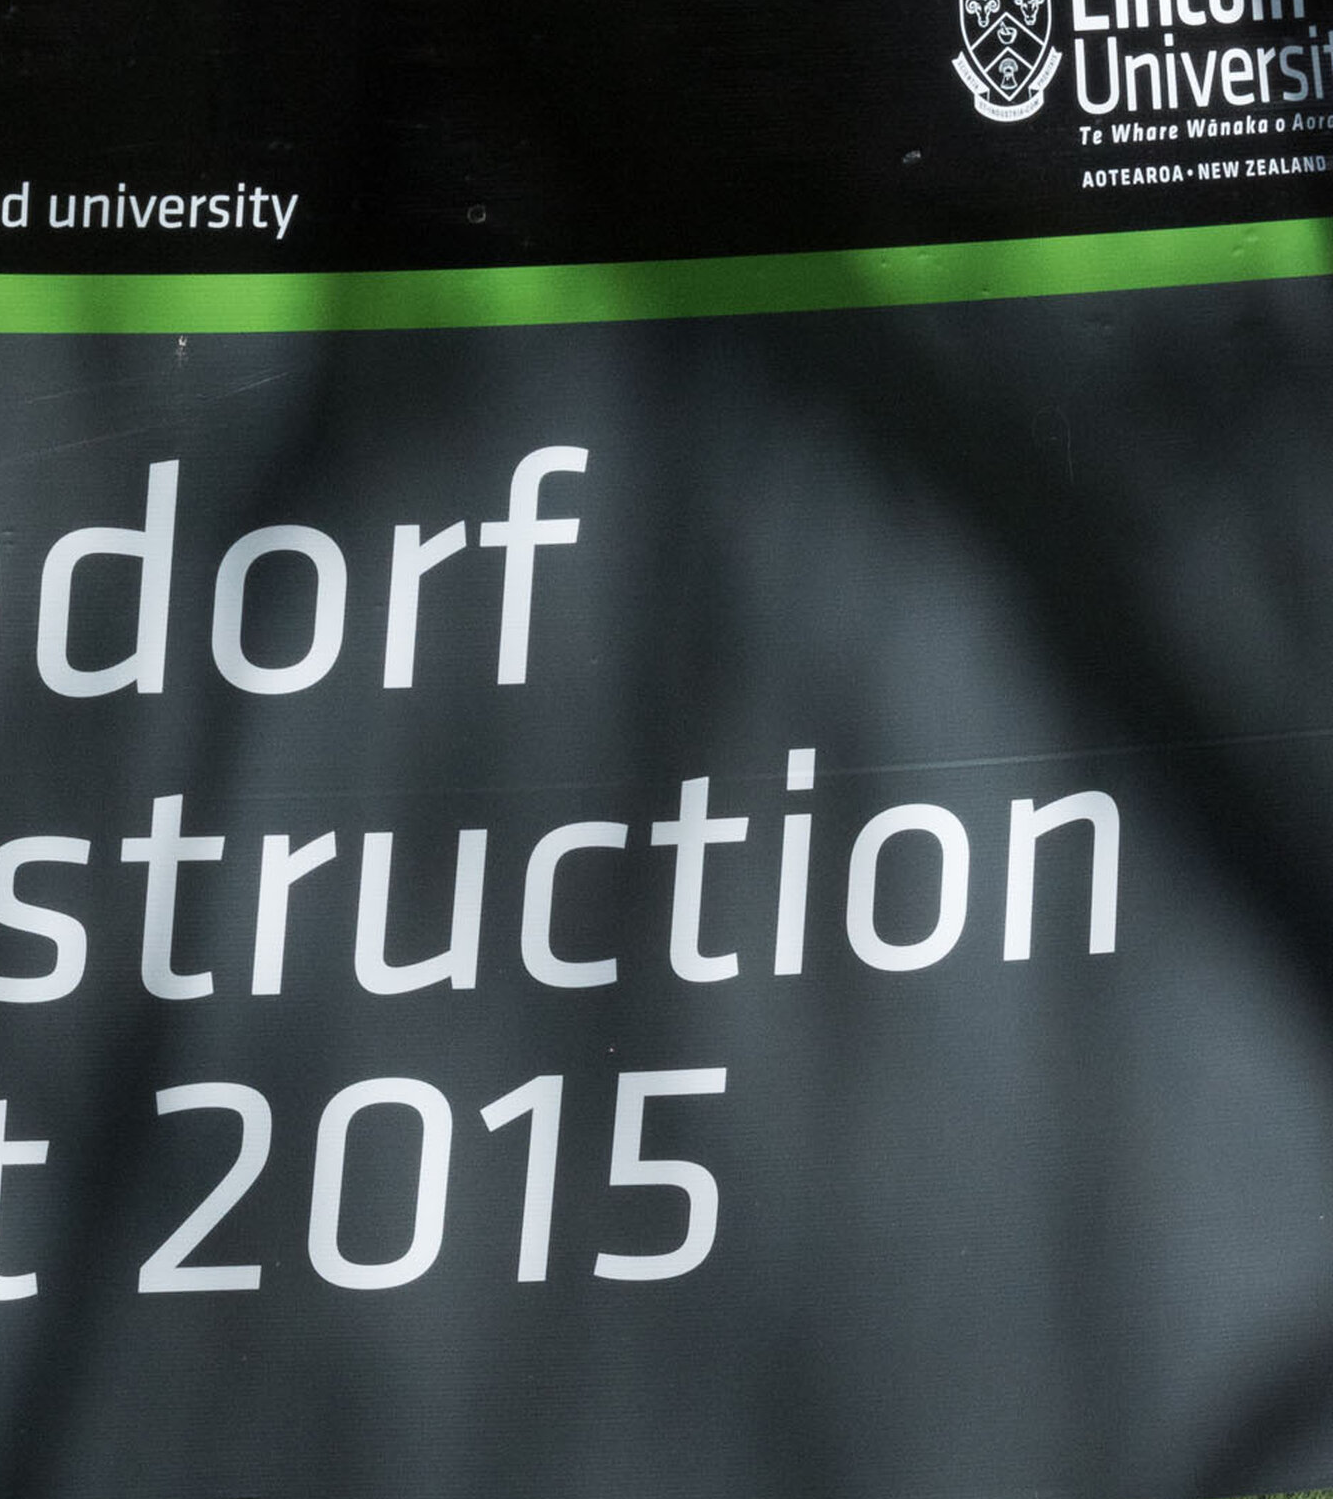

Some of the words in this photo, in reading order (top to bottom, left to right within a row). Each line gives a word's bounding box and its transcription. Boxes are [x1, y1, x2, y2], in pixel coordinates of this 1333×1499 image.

[1079, 125, 1104, 146] Te
[1111, 119, 1179, 143] Whare
[1186, 114, 1268, 139] Wānaka
[1275, 118, 1286, 134] o
[1245, 155, 1327, 178] ZEALAND
[49, 182, 299, 240] university
[138, 1067, 729, 1293] 2015
